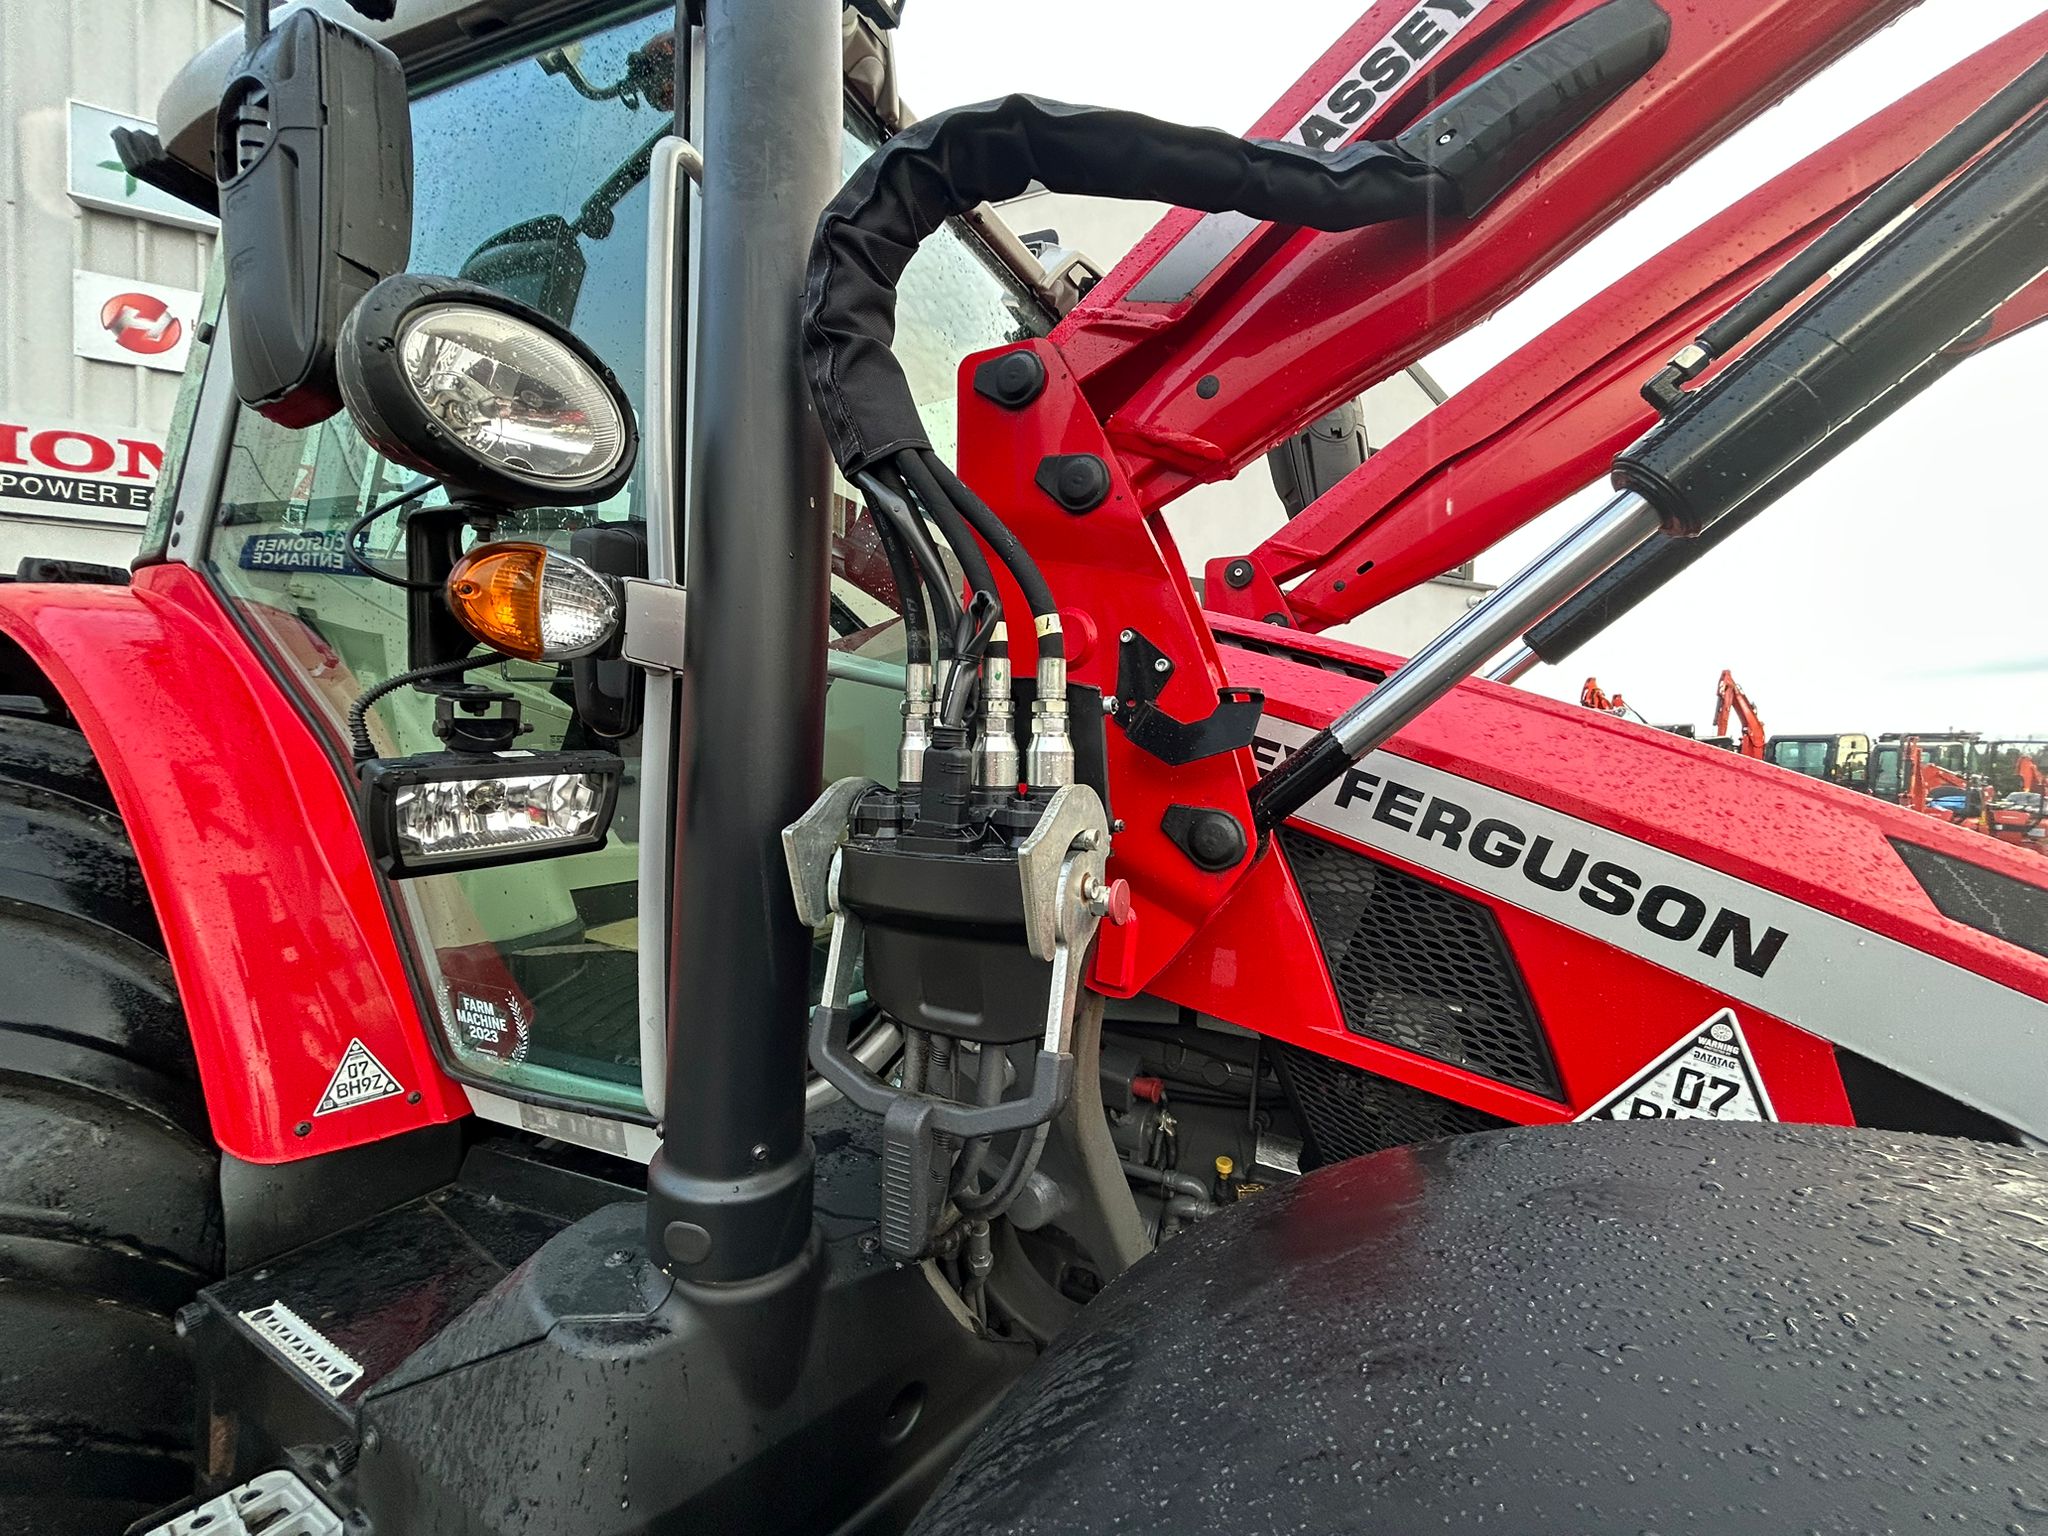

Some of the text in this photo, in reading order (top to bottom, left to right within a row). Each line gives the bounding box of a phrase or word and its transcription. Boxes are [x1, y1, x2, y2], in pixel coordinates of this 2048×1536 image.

[0, 473, 154, 508] POWER E
[1333, 766, 1789, 978] FERGUSON
[462, 996, 495, 1016] FARM
[456, 1008, 509, 1033] MACHINE
[468, 1024, 499, 1044] 2023
[1698, 1036, 1740, 1055] WARNING
[336, 1073, 384, 1099] BH9Z
[1672, 1066, 1740, 1118] 07
